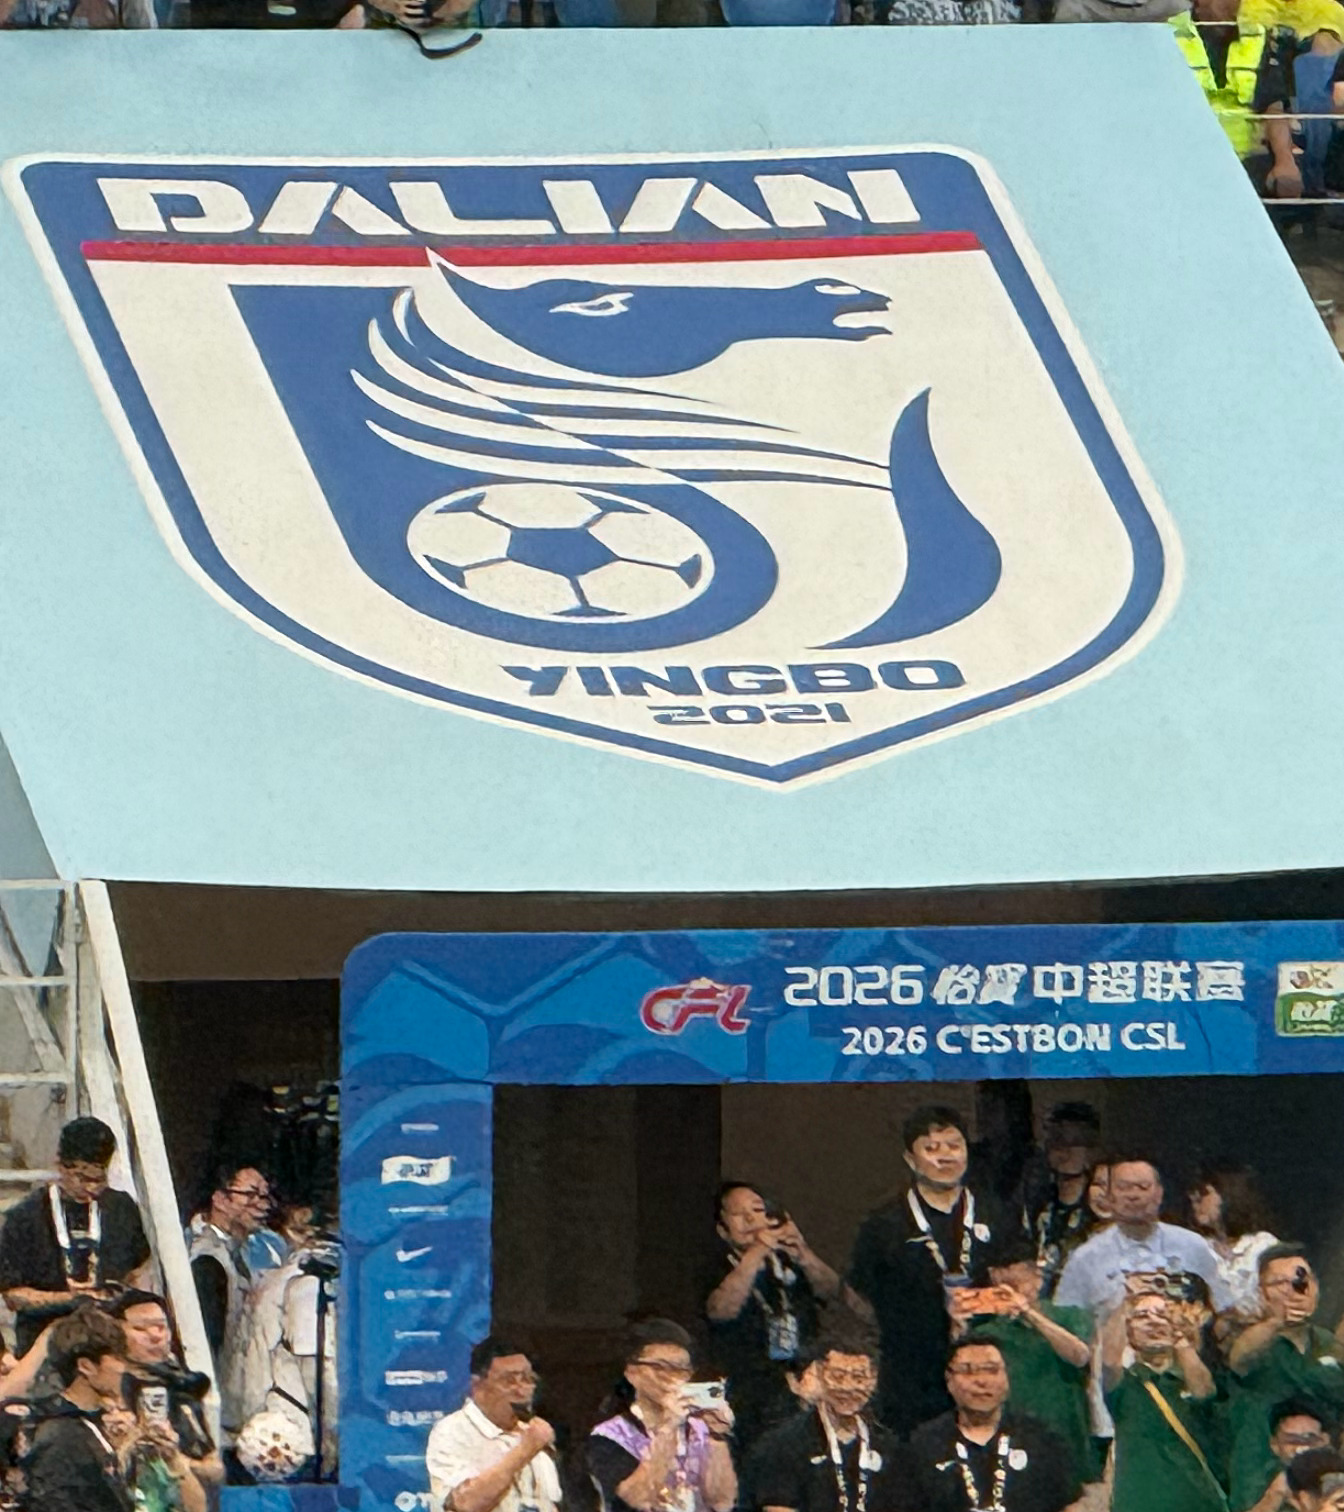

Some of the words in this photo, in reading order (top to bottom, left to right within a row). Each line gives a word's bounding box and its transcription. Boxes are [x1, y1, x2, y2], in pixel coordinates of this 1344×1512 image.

[97, 169, 922, 236] DALIAN
[500, 660, 966, 696] YINGBO
[646, 703, 852, 725] 2021
[841, 1025, 928, 1056] 2026
[1120, 1022, 1187, 1051] CSL
